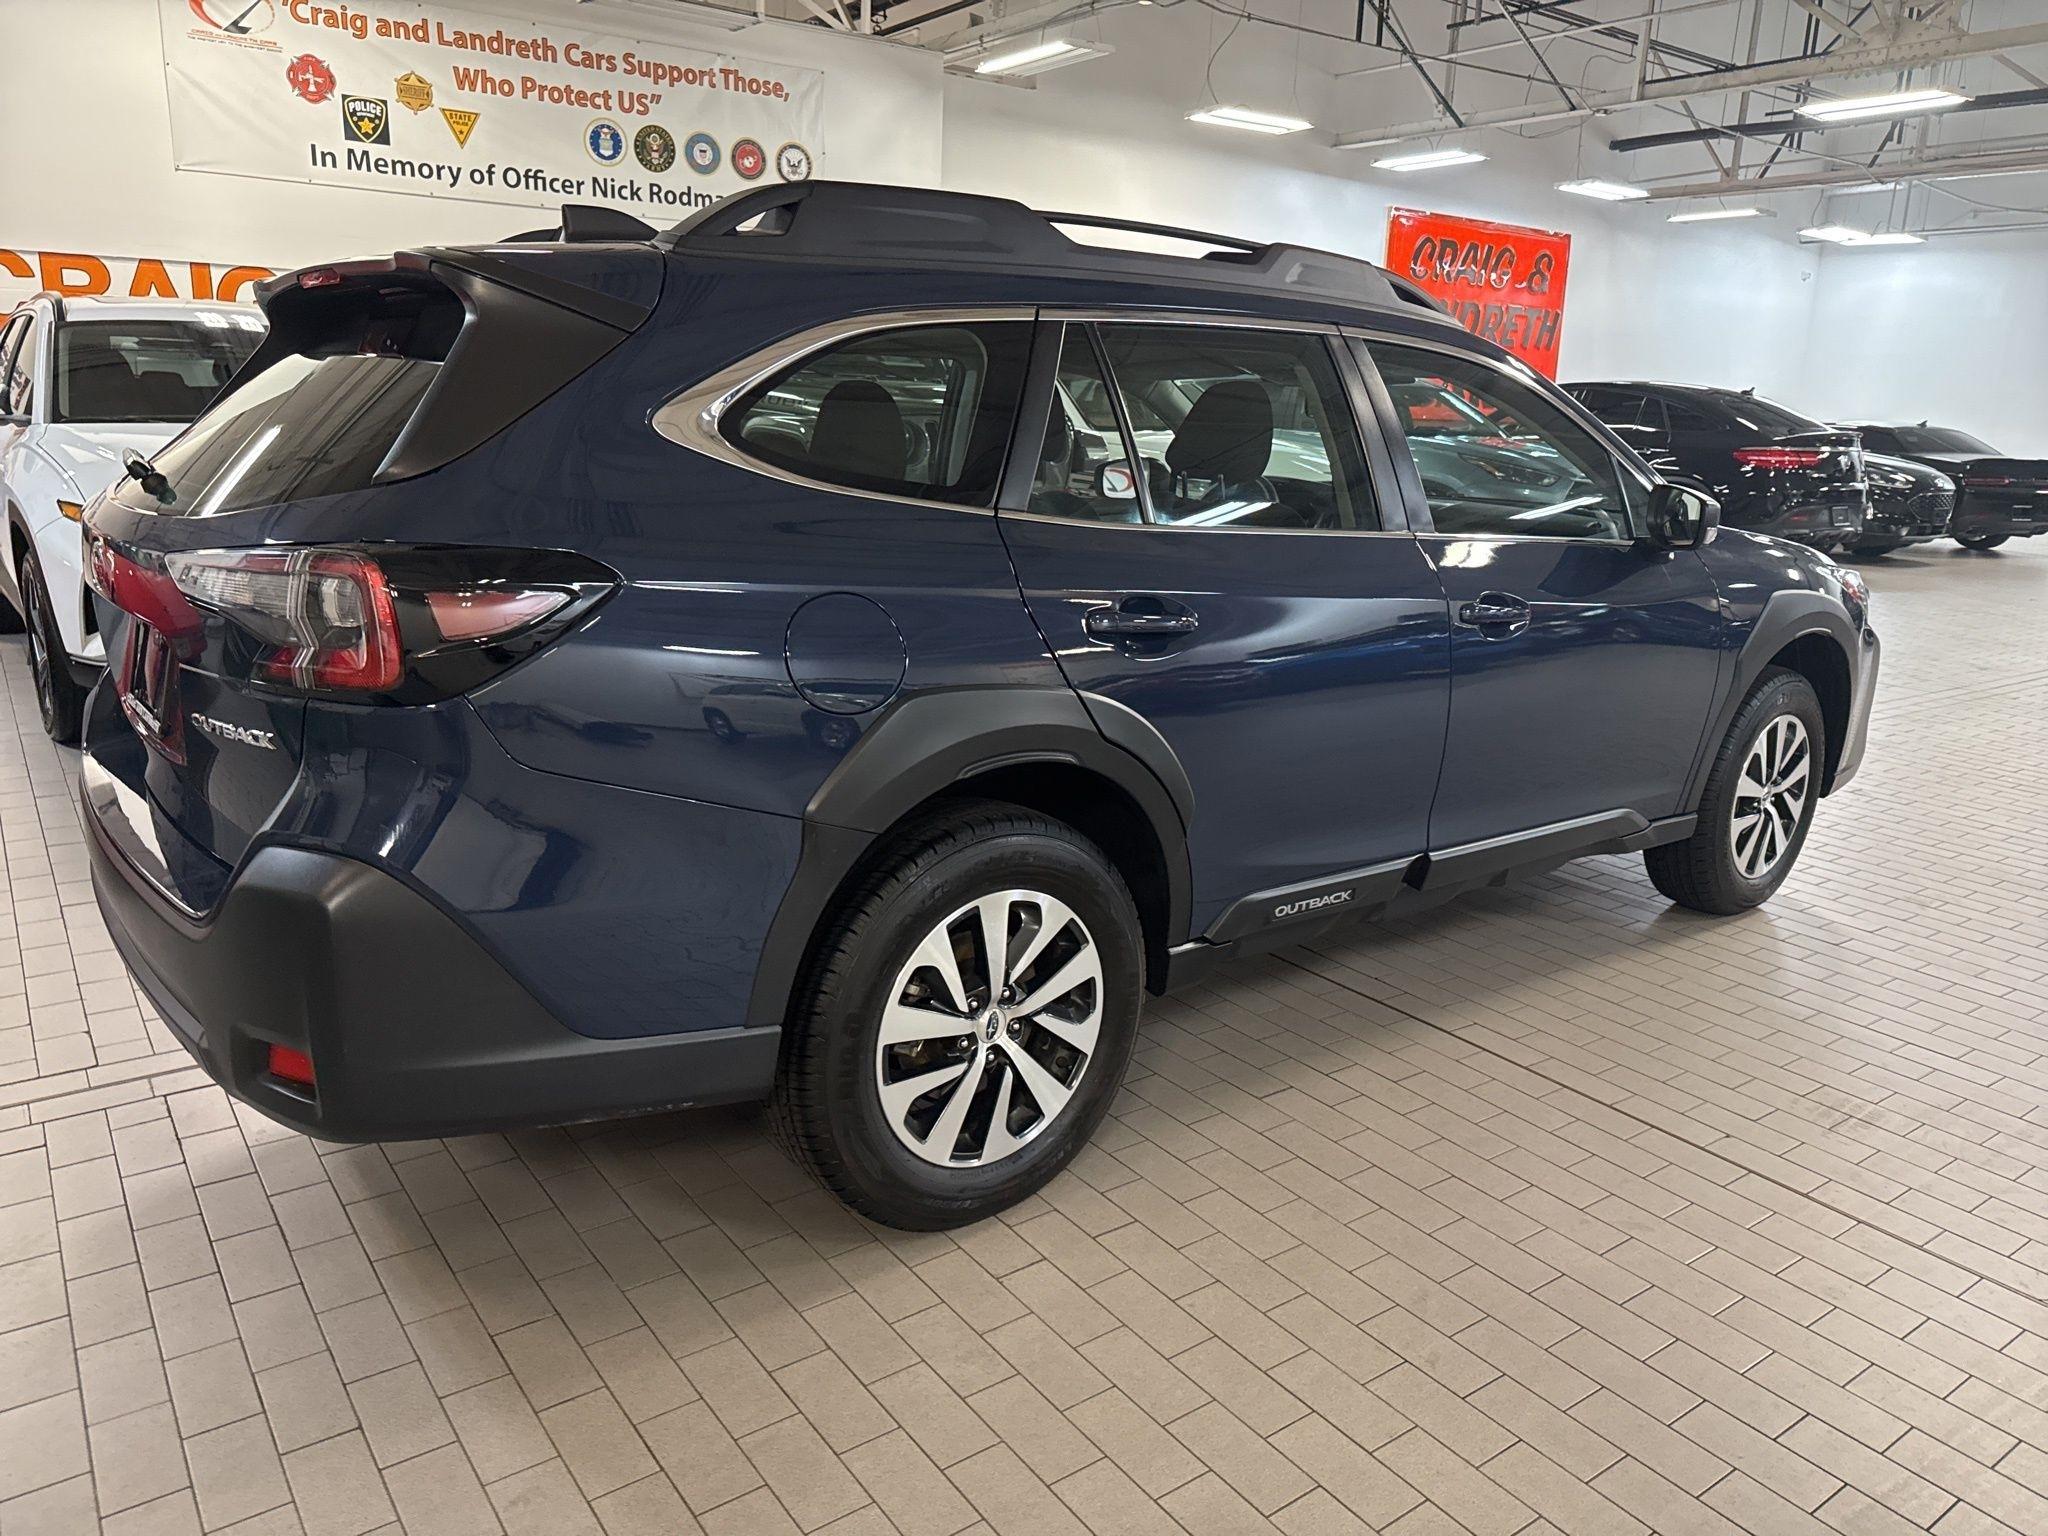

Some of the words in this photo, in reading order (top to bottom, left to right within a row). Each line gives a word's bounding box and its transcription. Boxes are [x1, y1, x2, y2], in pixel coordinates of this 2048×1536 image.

[376, 18, 430, 43] and
[436, 22, 558, 63] Landreth
[563, 43, 618, 73] Cars
[623, 53, 717, 88] Support
[719, 68, 790, 102] Those,
[348, 100, 382, 117] POLICE
[402, 85, 426, 99] SHERIFF
[453, 66, 515, 97] Who
[521, 76, 612, 111] Protect
[617, 90, 662, 116] US"
[449, 112, 472, 123] STATE
[310, 143, 338, 169] In
[346, 147, 462, 188] Memory
[469, 163, 496, 186] of
[502, 166, 585, 196] Officer
[592, 176, 643, 202] Nick
[649, 182, 725, 208] Rodm
[1409, 234, 1516, 288] CRAIG
[1526, 250, 1555, 295] &
[191, 712, 277, 750] OUTBACK
[1274, 889, 1353, 918] OUTBACK
